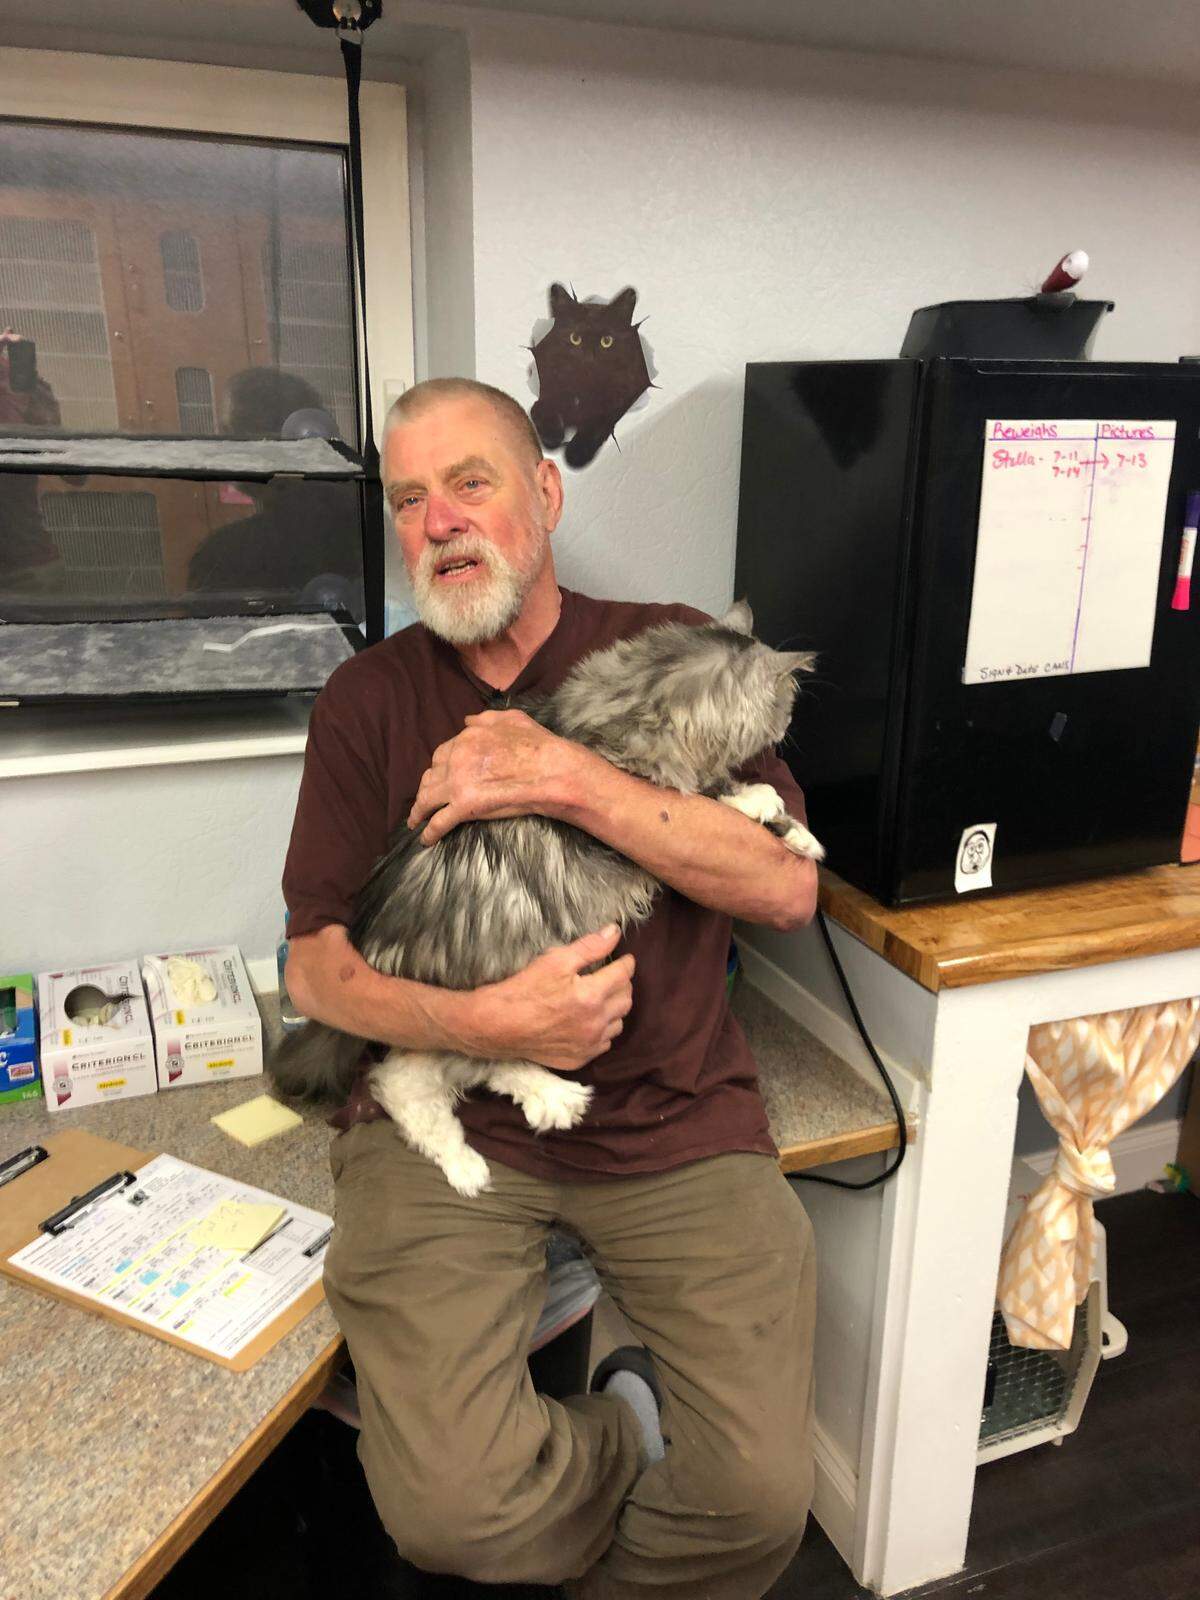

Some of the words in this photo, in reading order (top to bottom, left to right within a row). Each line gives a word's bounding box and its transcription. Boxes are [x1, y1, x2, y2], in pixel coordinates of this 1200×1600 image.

[992, 421, 1058, 439] Reweighs
[1101, 422, 1155, 440] Pictures
[1116, 453, 1149, 469] 7-13
[1051, 466, 1081, 479] 7-14
